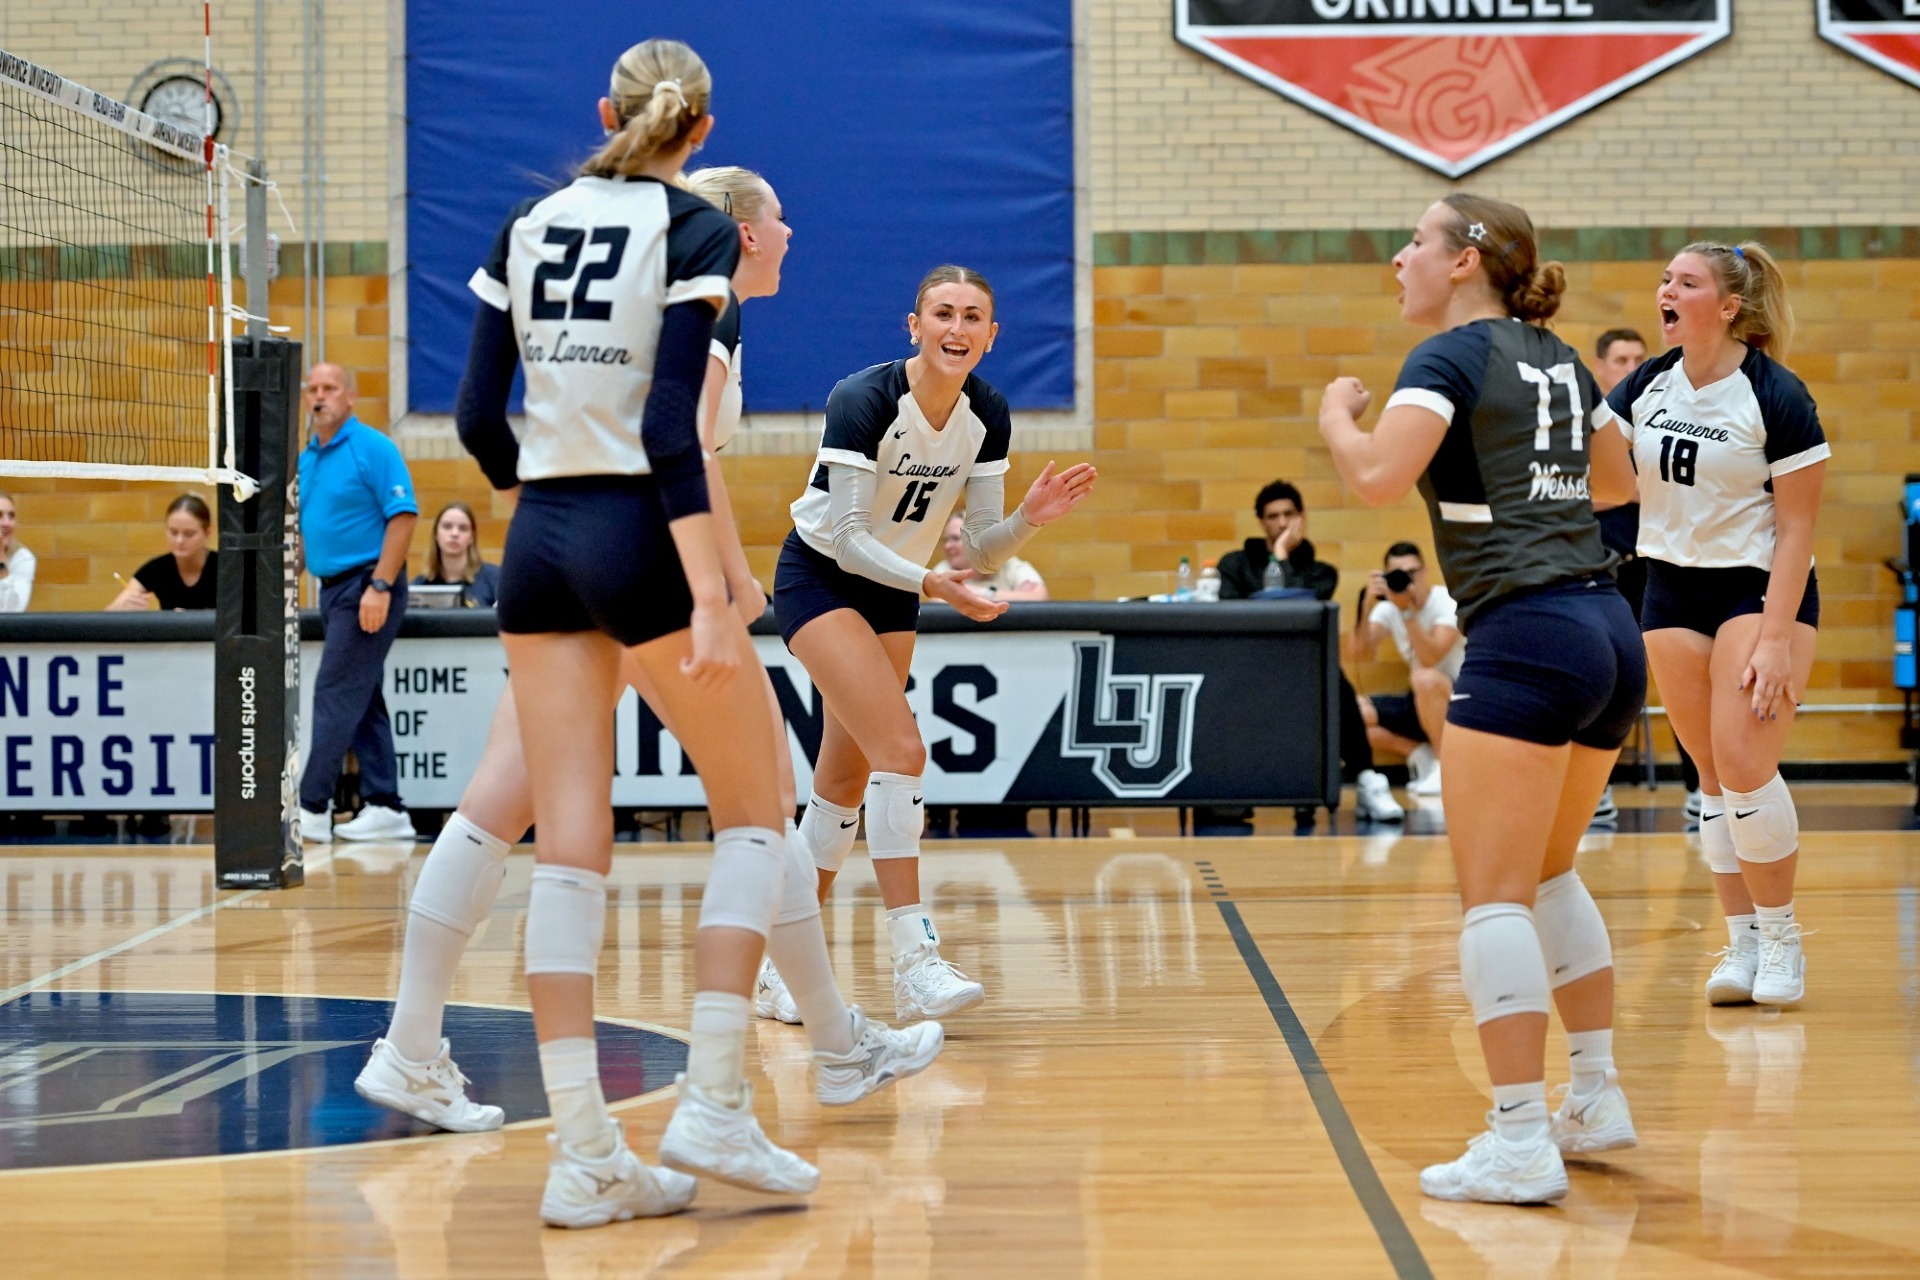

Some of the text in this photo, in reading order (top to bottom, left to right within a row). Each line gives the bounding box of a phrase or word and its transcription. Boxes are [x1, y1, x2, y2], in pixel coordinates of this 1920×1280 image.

[531, 226, 630, 321] 22
[549, 329, 632, 365] Lannen
[1516, 361, 1584, 451] 77
[1644, 408, 1729, 442] Lawrence
[1659, 435, 1699, 487] 18
[891, 480, 939, 523] 15
[395, 667, 468, 694] HOME
[238, 666, 257, 800] sports imports
[396, 710, 428, 737] OF
[395, 752, 447, 778] THE
